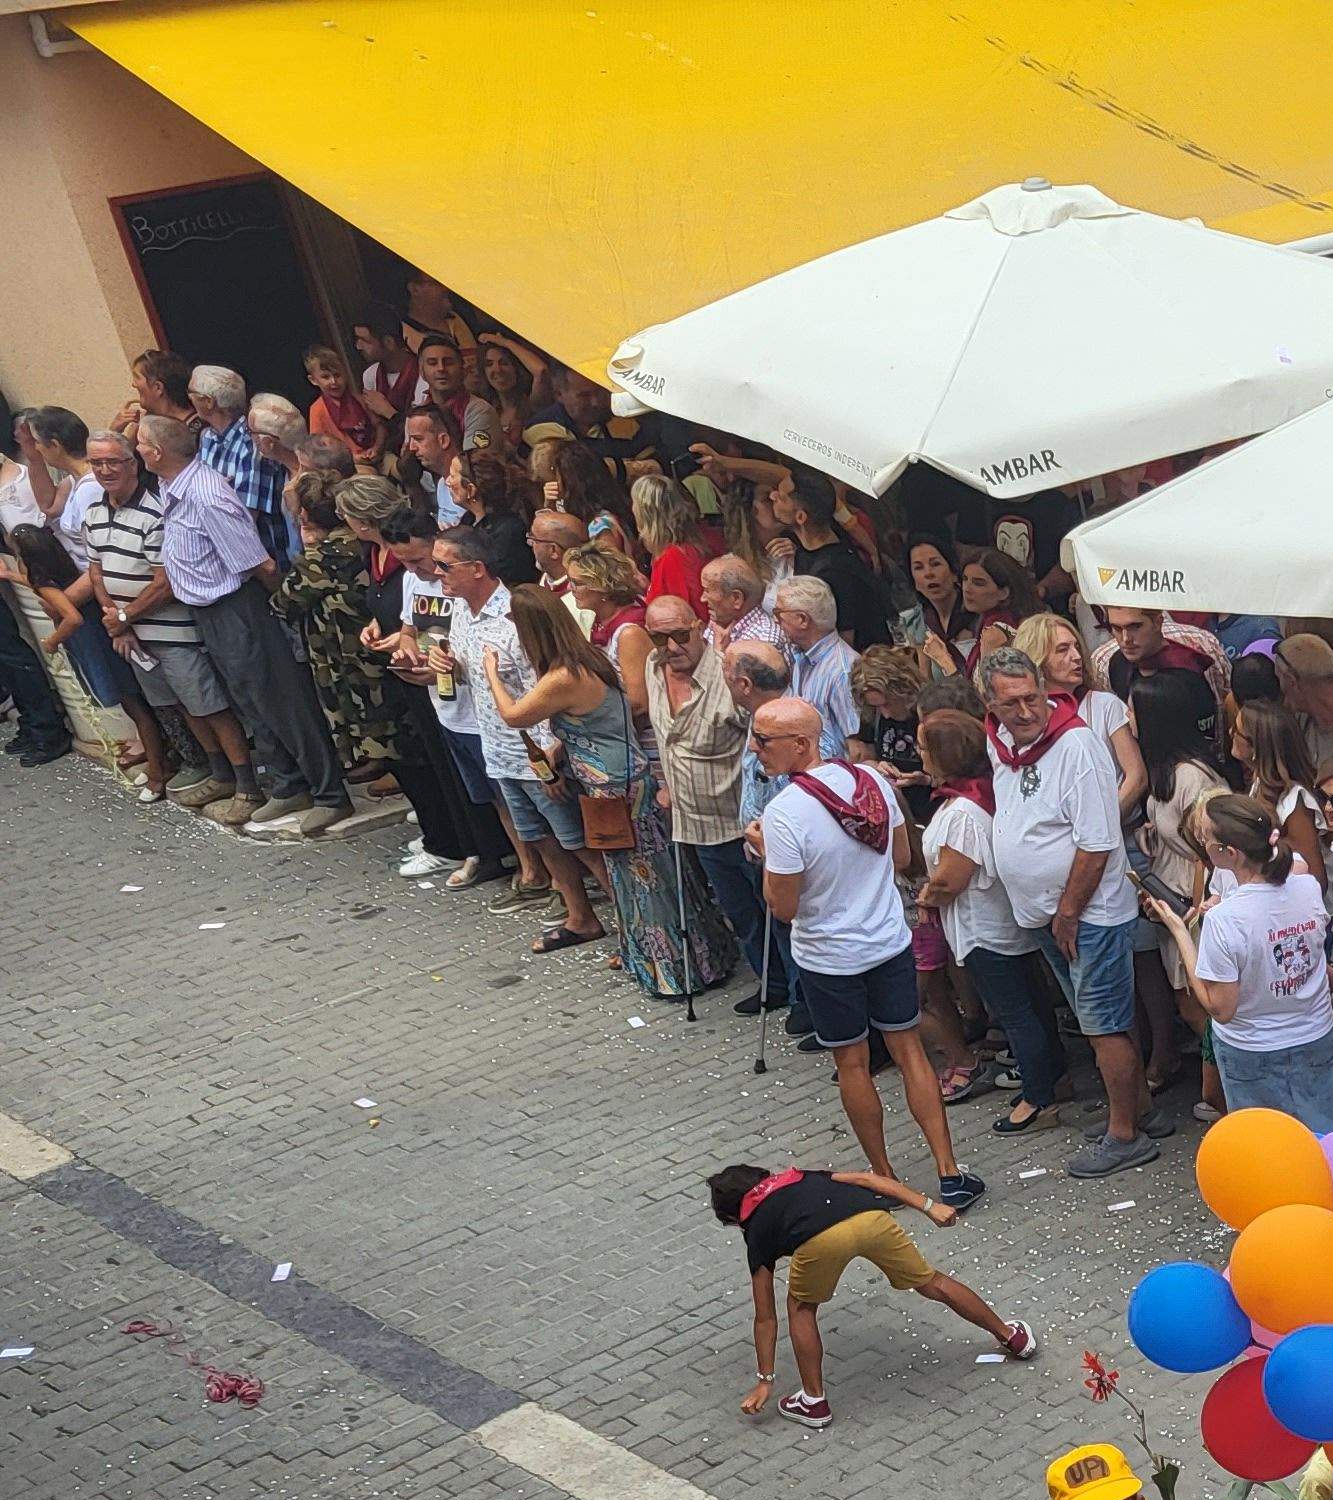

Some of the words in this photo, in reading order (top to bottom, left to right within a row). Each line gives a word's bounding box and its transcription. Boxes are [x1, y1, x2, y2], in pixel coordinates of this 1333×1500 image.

[617, 368, 667, 397] AMBAR
[783, 428, 834, 459] CERVECEROS
[979, 448, 1063, 487] AMBAR
[1115, 568, 1186, 594] AMBAR
